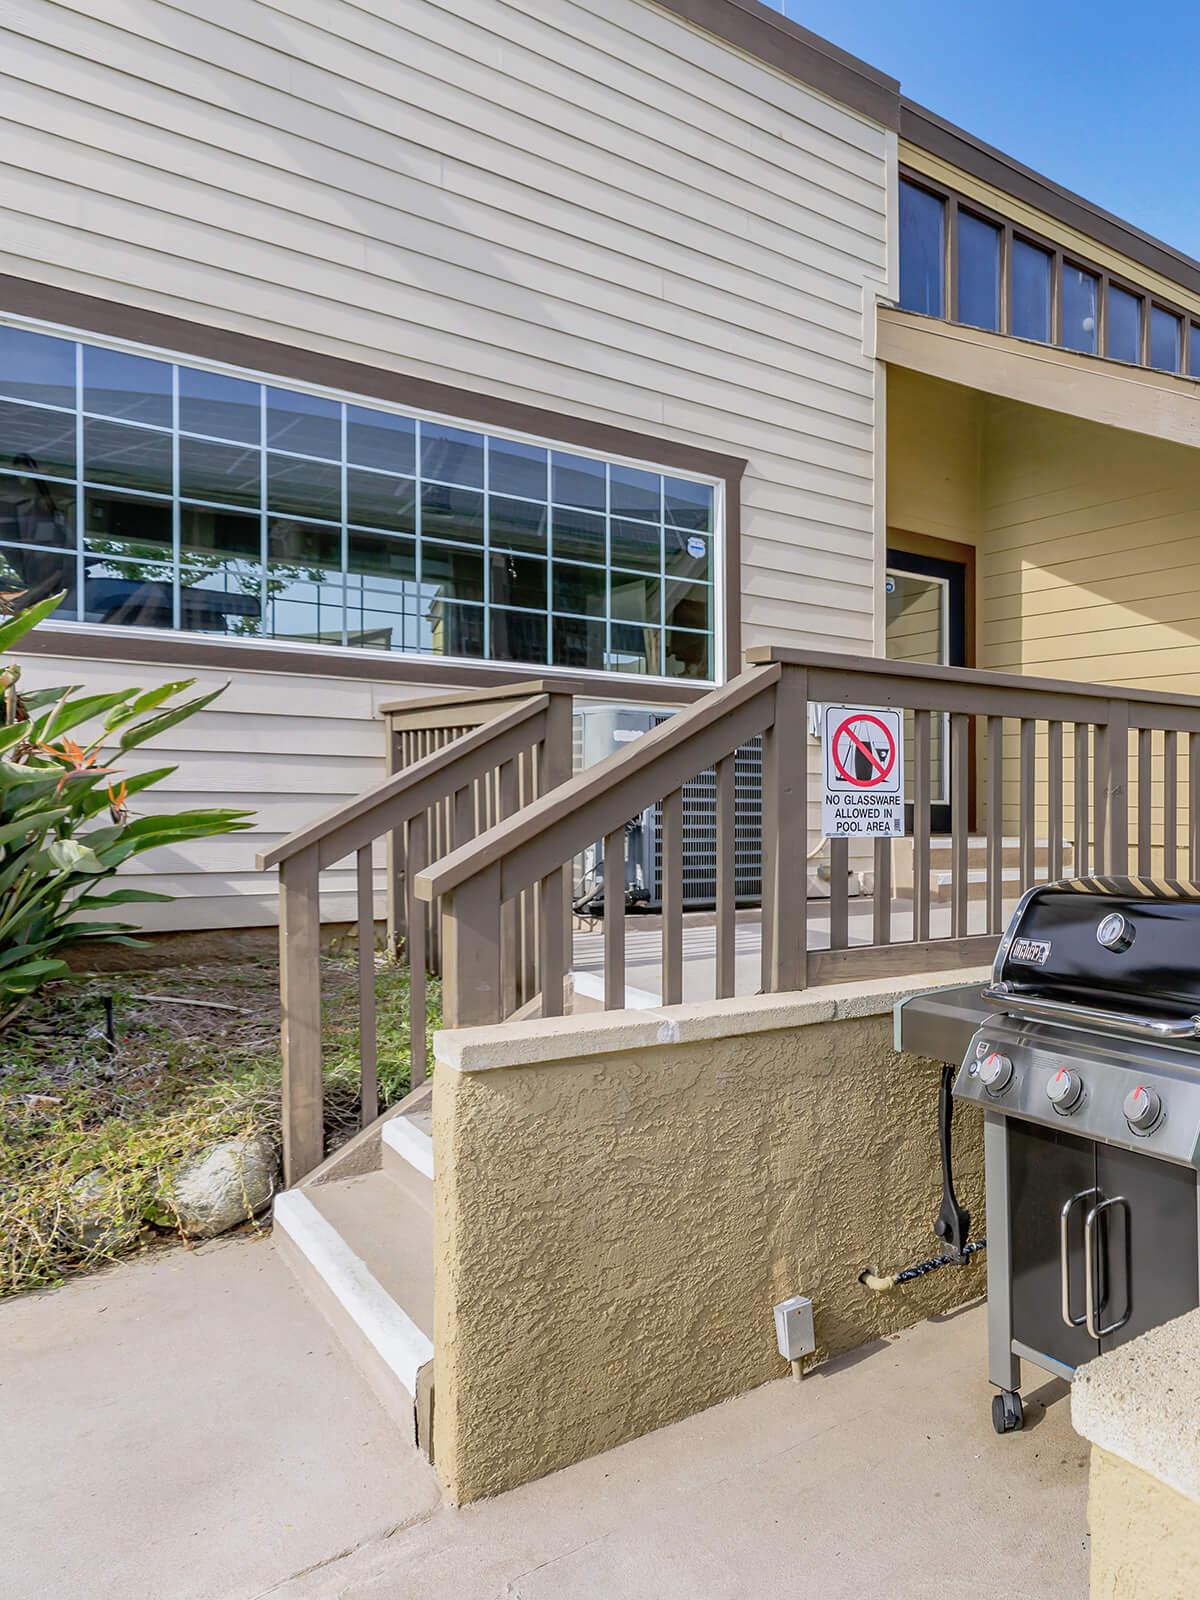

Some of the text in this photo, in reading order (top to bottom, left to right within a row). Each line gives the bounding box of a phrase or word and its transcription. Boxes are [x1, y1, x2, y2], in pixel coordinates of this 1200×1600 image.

[825, 795, 901, 805] NO GLASSWARE
[835, 808, 892, 818] ALLOWED IN
[836, 822, 890, 832] POOL AREA
